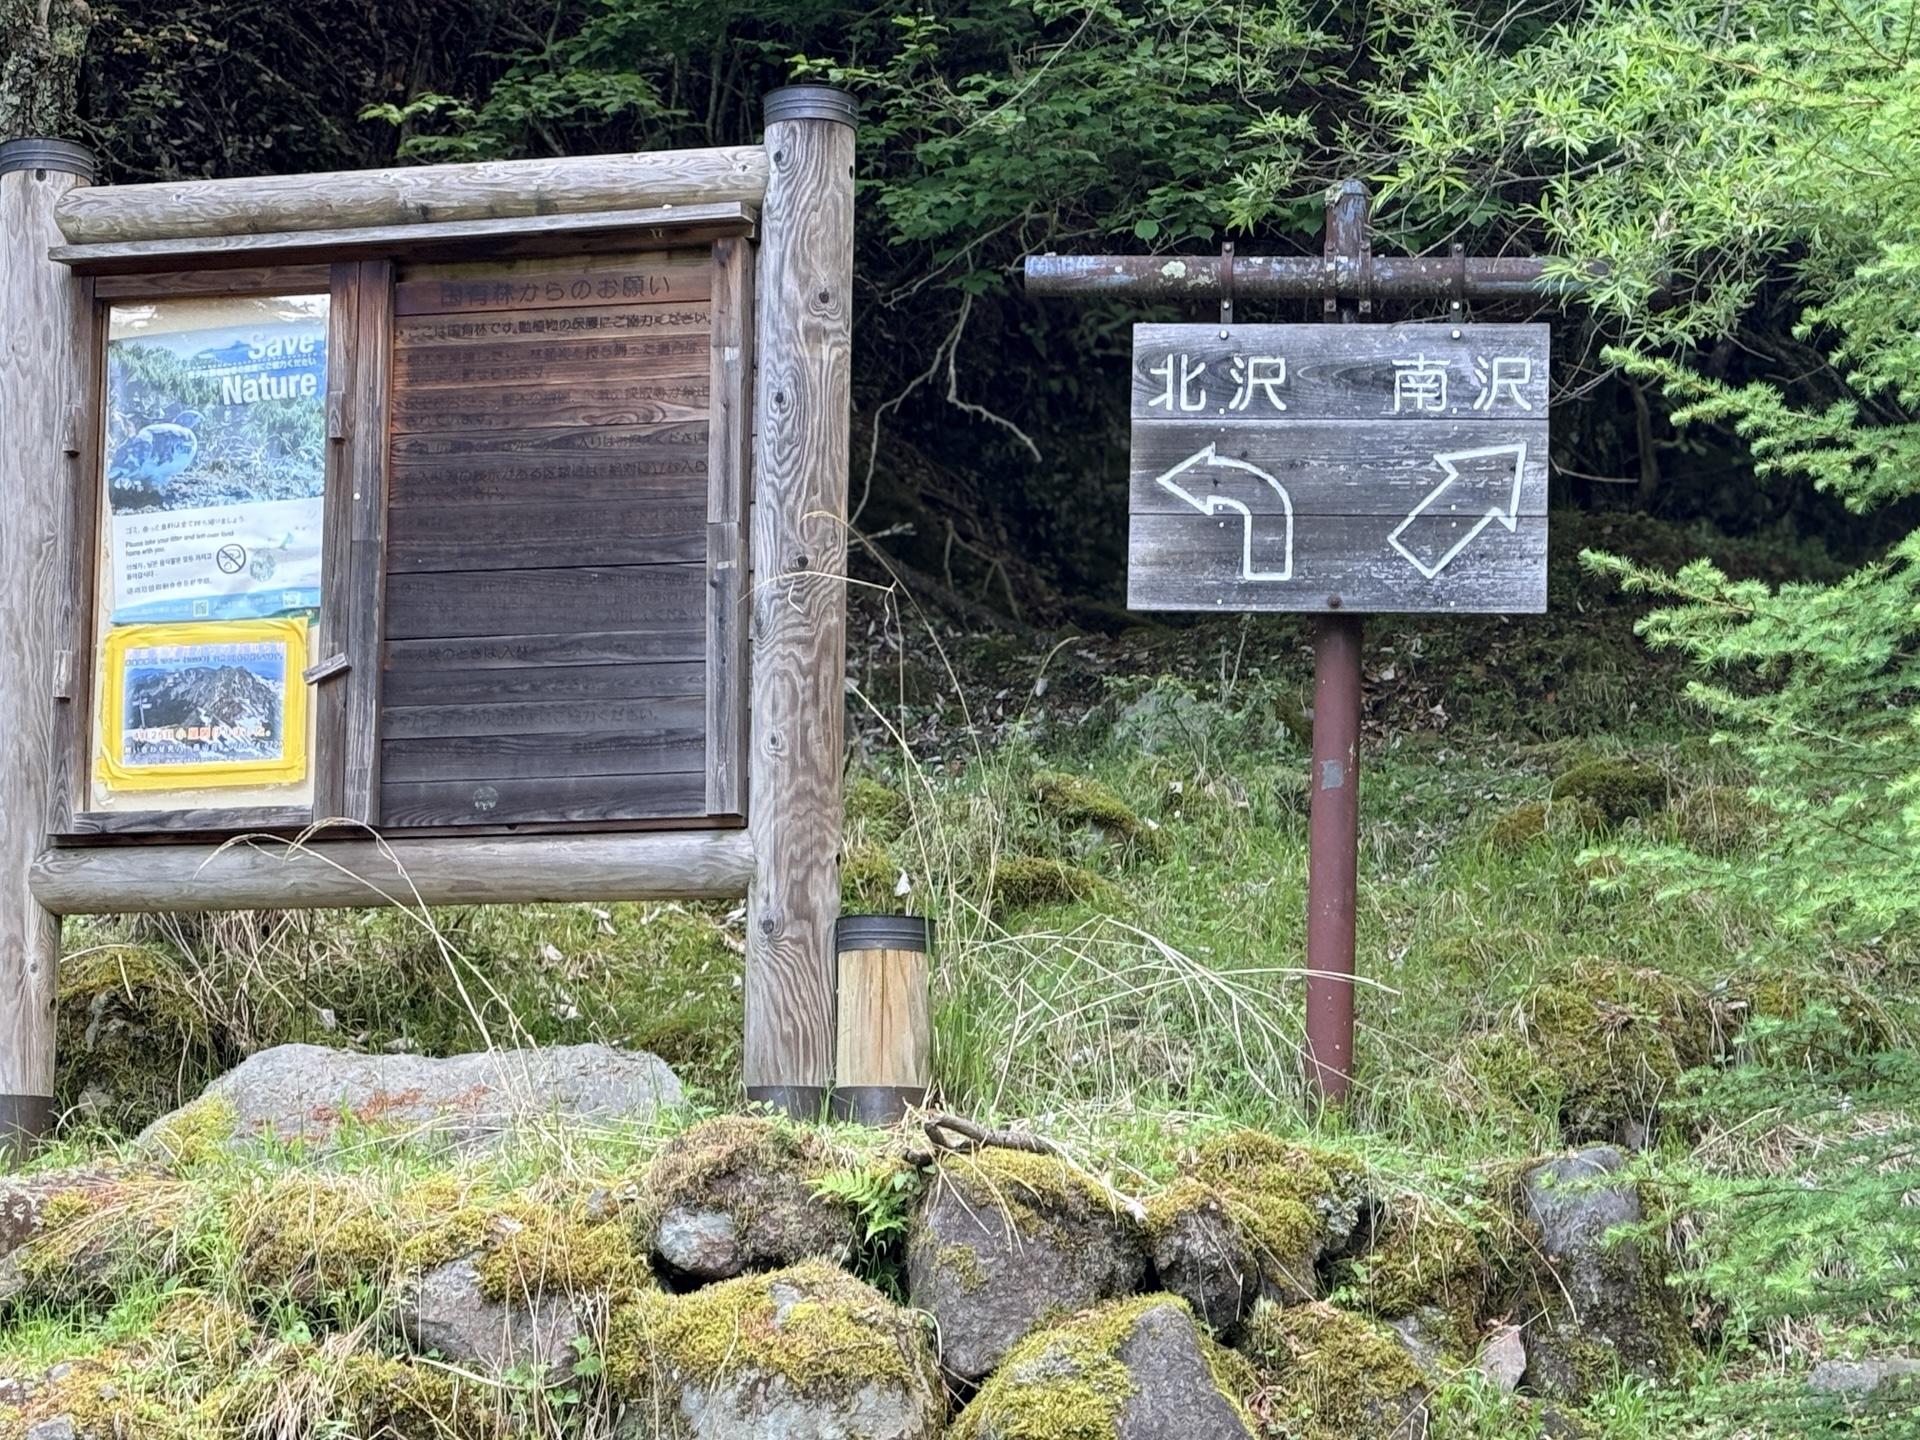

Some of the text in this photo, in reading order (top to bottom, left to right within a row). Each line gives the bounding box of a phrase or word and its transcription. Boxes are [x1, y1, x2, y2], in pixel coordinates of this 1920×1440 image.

[439, 275, 671, 307] 国有林からのお願い
[247, 331, 316, 359] Save
[221, 372, 318, 406] Nature
[1147, 353, 1533, 413] 北沢 南沢
